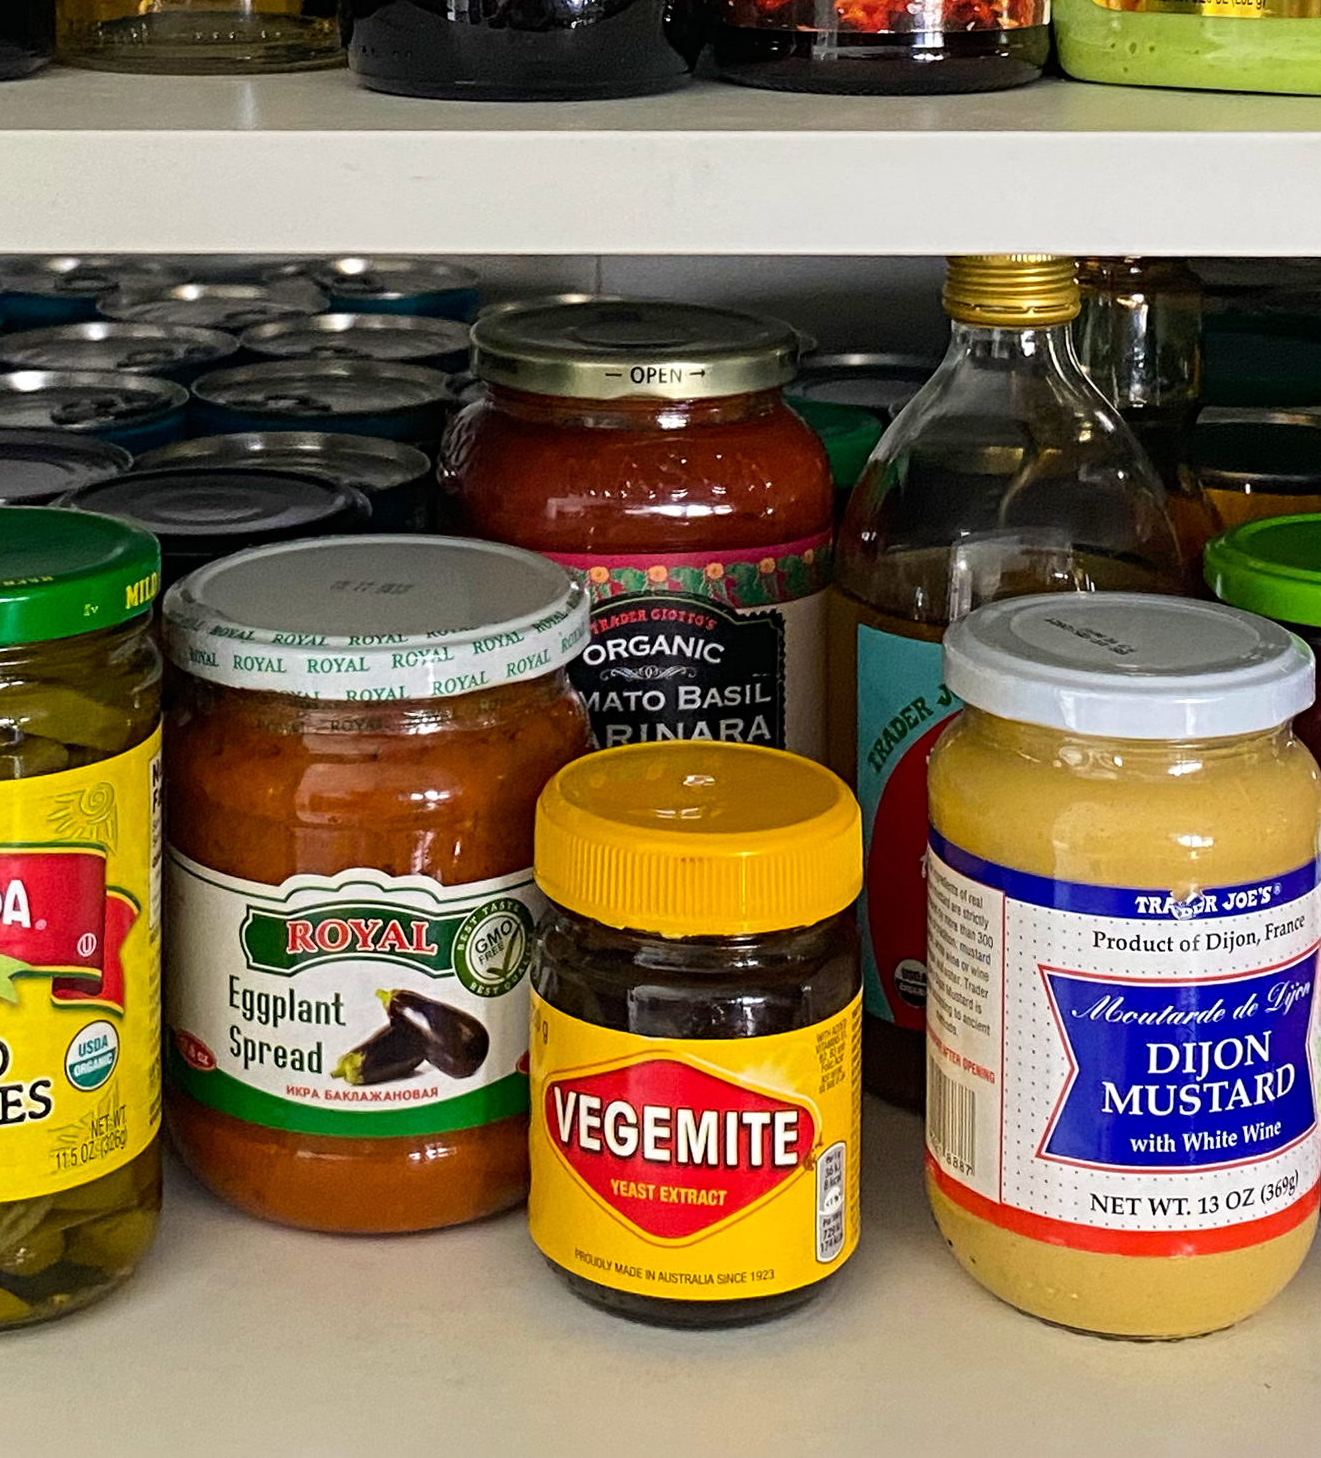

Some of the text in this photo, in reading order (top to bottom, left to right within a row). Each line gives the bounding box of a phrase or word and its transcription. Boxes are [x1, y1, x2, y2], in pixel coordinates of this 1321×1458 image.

[630, 367, 682, 383] OPEN
[233, 630, 525, 674] ROYAL ROYAL ROYAL ROYAL
[583, 634, 724, 666] ORGANIC
[287, 919, 437, 955] ROYAL
[474, 920, 513, 954] GMO
[1093, 914, 1305, 954] Product of Dijon, France
[229, 975, 347, 1028] Eggplant
[1072, 979, 1311, 1026] Moutarde de Dijon
[230, 1025, 323, 1074] Spread
[1147, 1031, 1272, 1081] DIJON
[286, 1085, 438, 1102] ИКРА БАКЛАЖАНОВАЯ
[1102, 1064, 1295, 1116] MUSTARD
[554, 1086, 798, 1166] VEGEMITE
[1130, 1120, 1282, 1153] with White Wine
[610, 1179, 727, 1206] YEAST EXTRACT
[1090, 1169, 1300, 1217] NET WT. 13 OZ (369g)
[575, 1248, 775, 1284] PROUDLY MADE IN AUSTRALIA SINCE 1923
